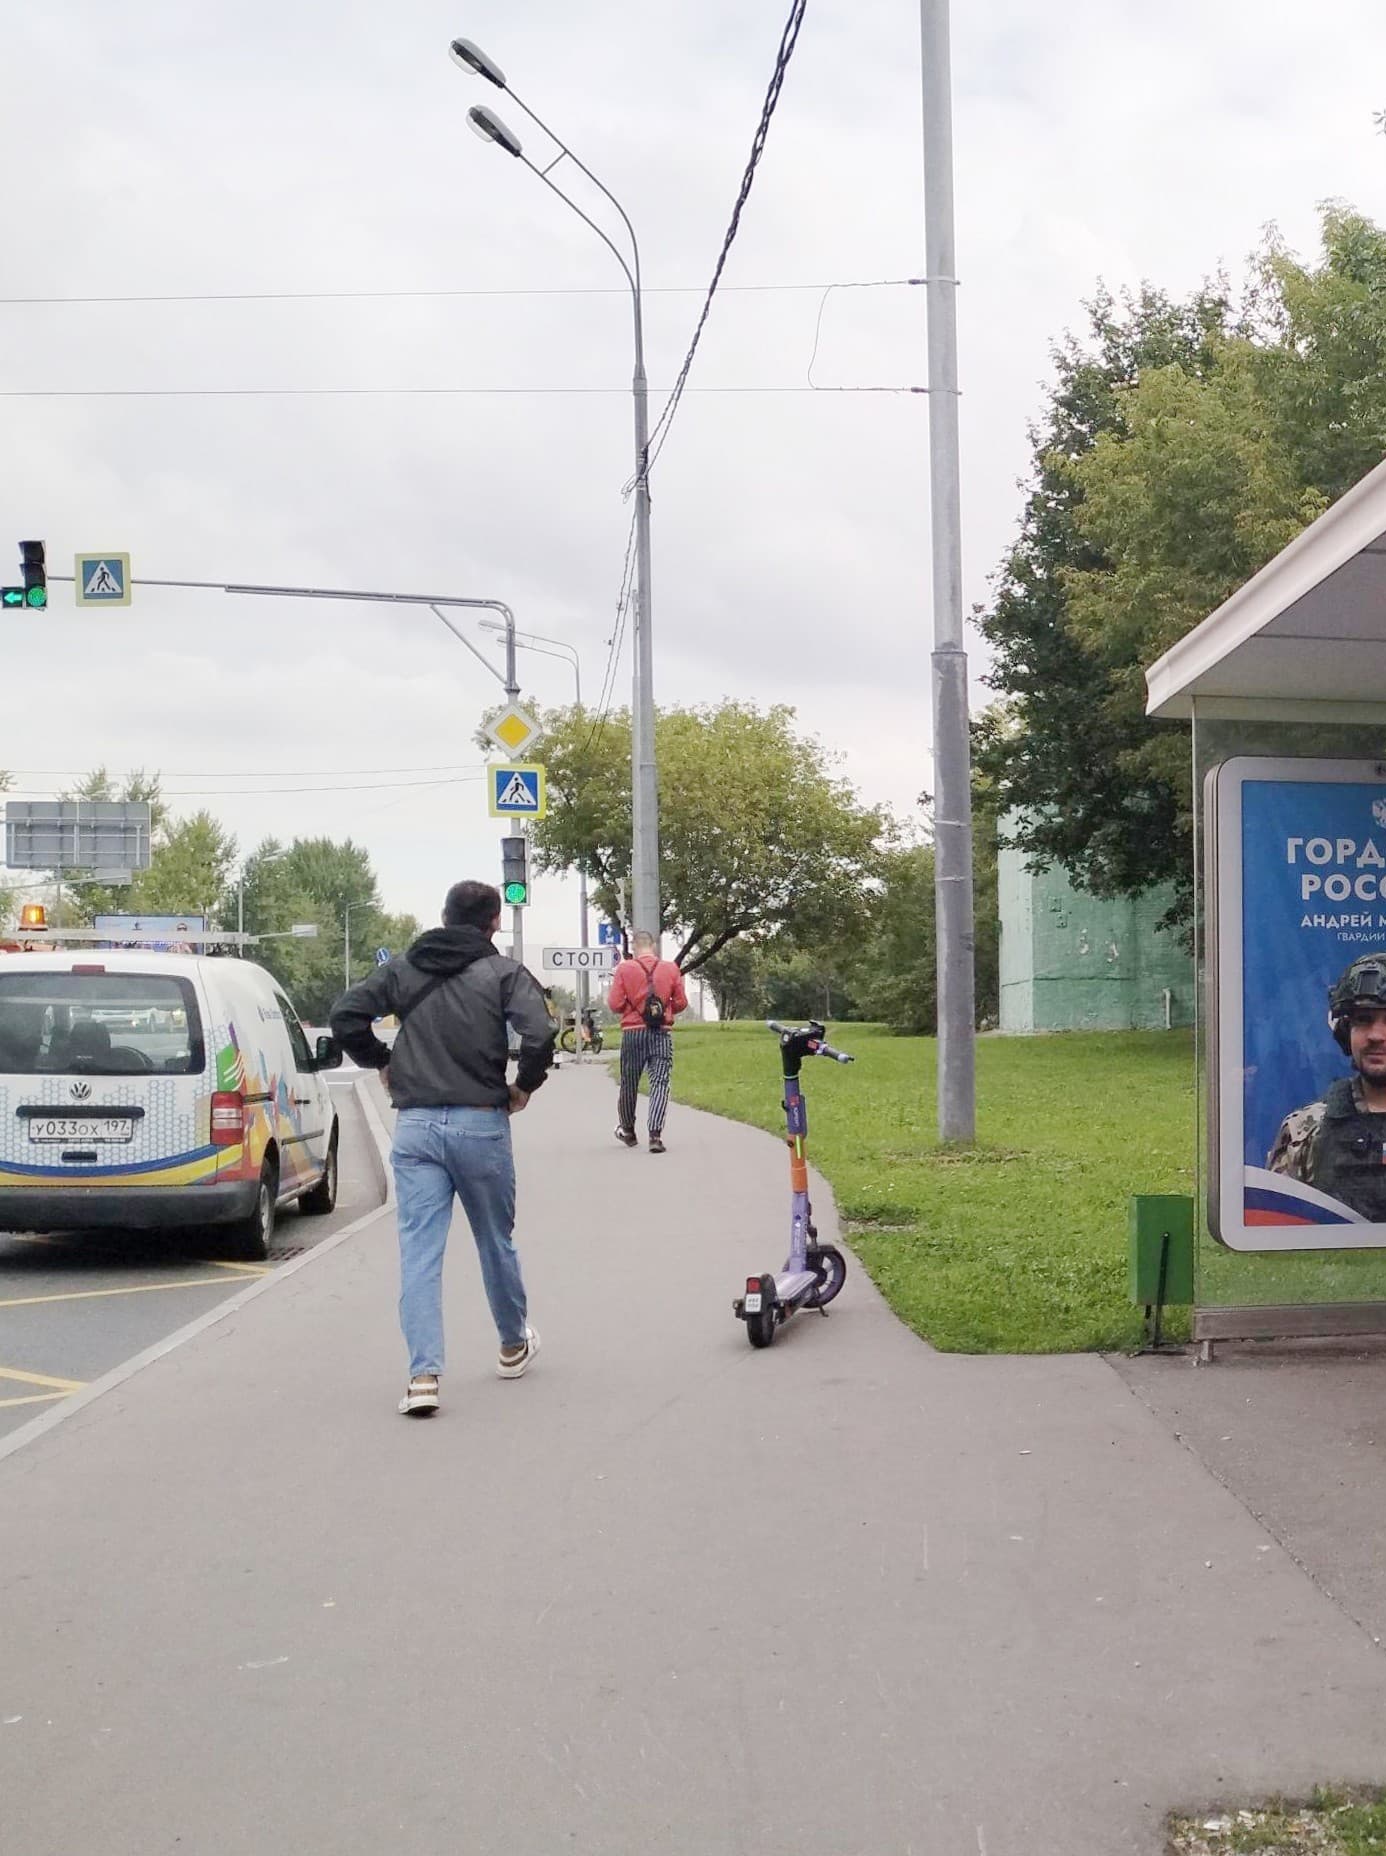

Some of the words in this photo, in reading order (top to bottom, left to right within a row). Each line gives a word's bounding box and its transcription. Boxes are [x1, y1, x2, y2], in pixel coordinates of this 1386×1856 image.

[1300, 911, 1372, 929] АНДРЕЙ
[1336, 932, 1385, 942] ГВАРДИИ
[552, 951, 604, 966] СТОП
